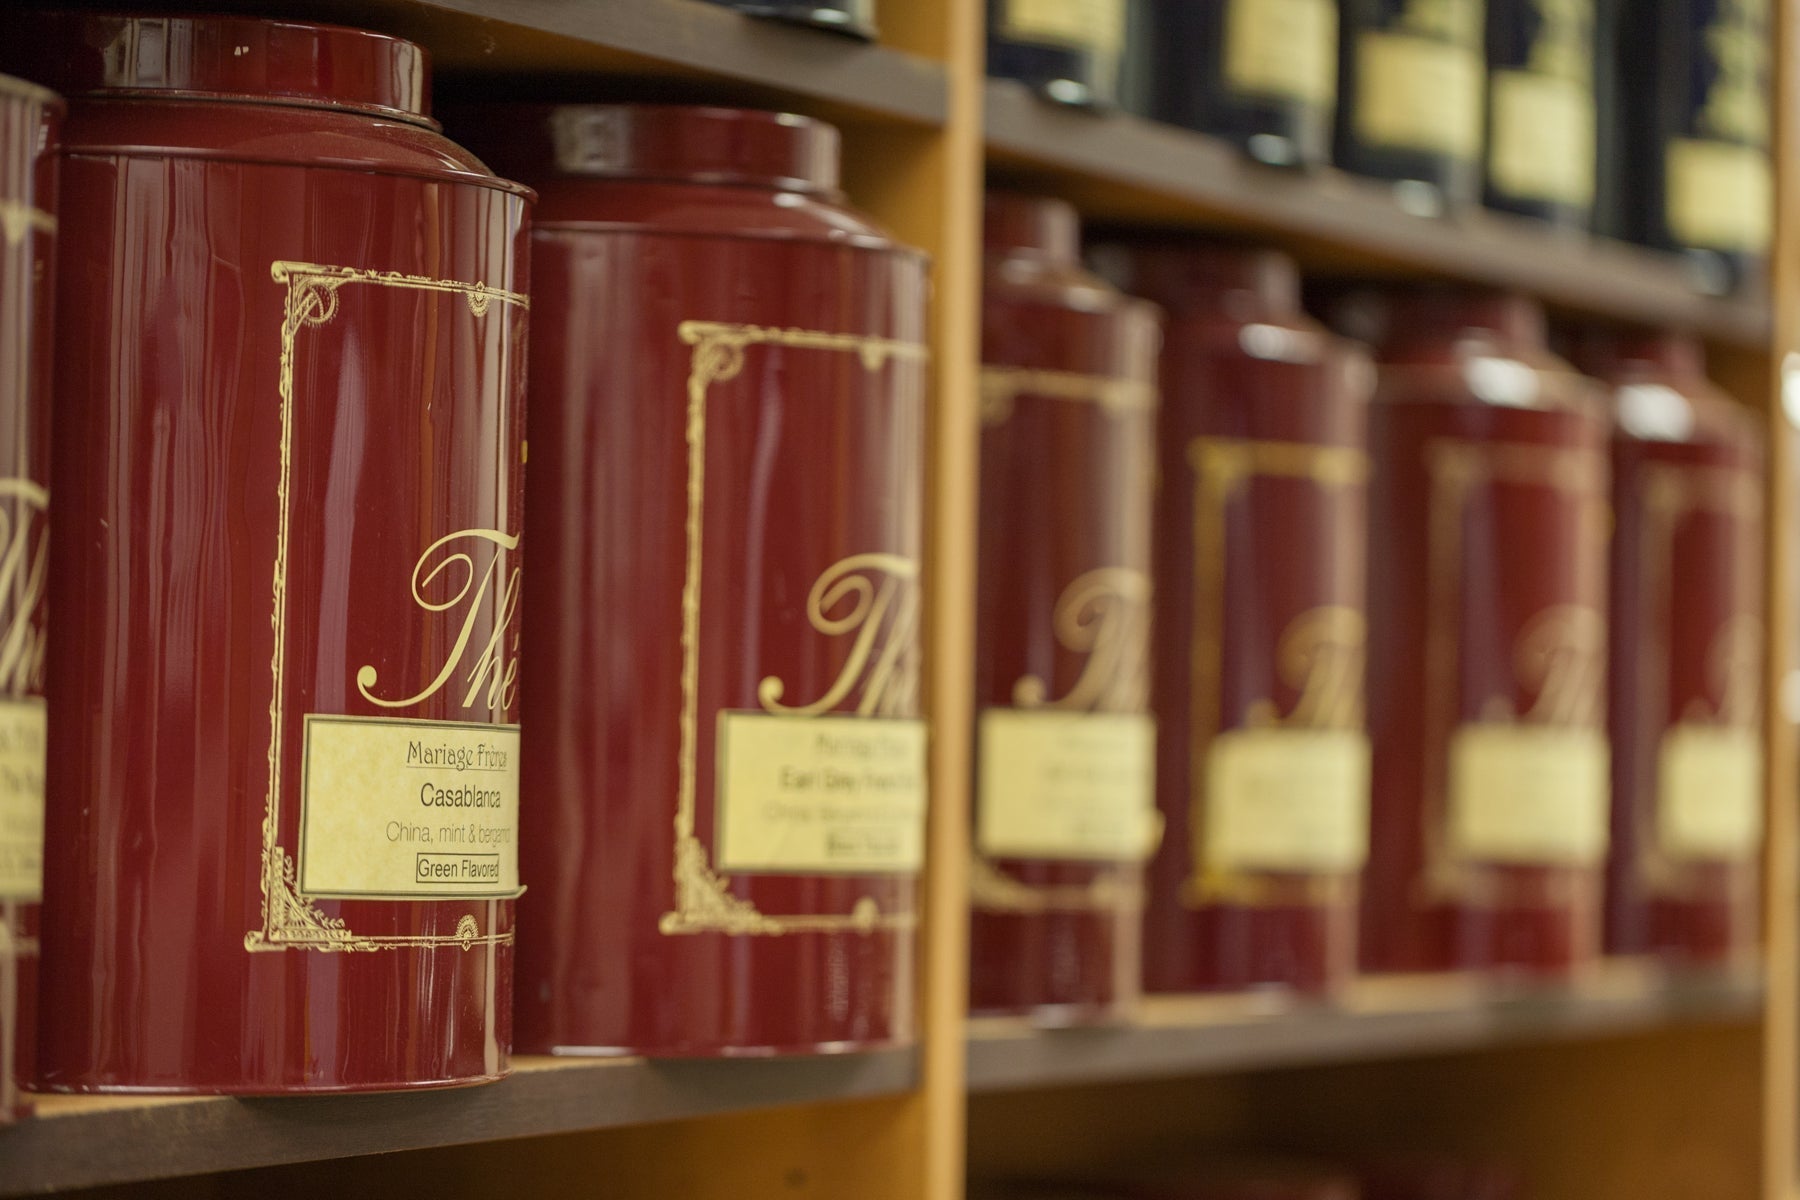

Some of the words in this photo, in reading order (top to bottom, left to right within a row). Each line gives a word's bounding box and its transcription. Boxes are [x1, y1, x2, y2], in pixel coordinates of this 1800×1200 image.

[406, 740, 473, 772] Mariage
[420, 782, 501, 808] Casablanca
[386, 820, 434, 847] China,
[438, 823, 466, 844] mint
[468, 823, 476, 844] &
[417, 858, 458, 878] Green
[461, 859, 499, 878] Flavored
